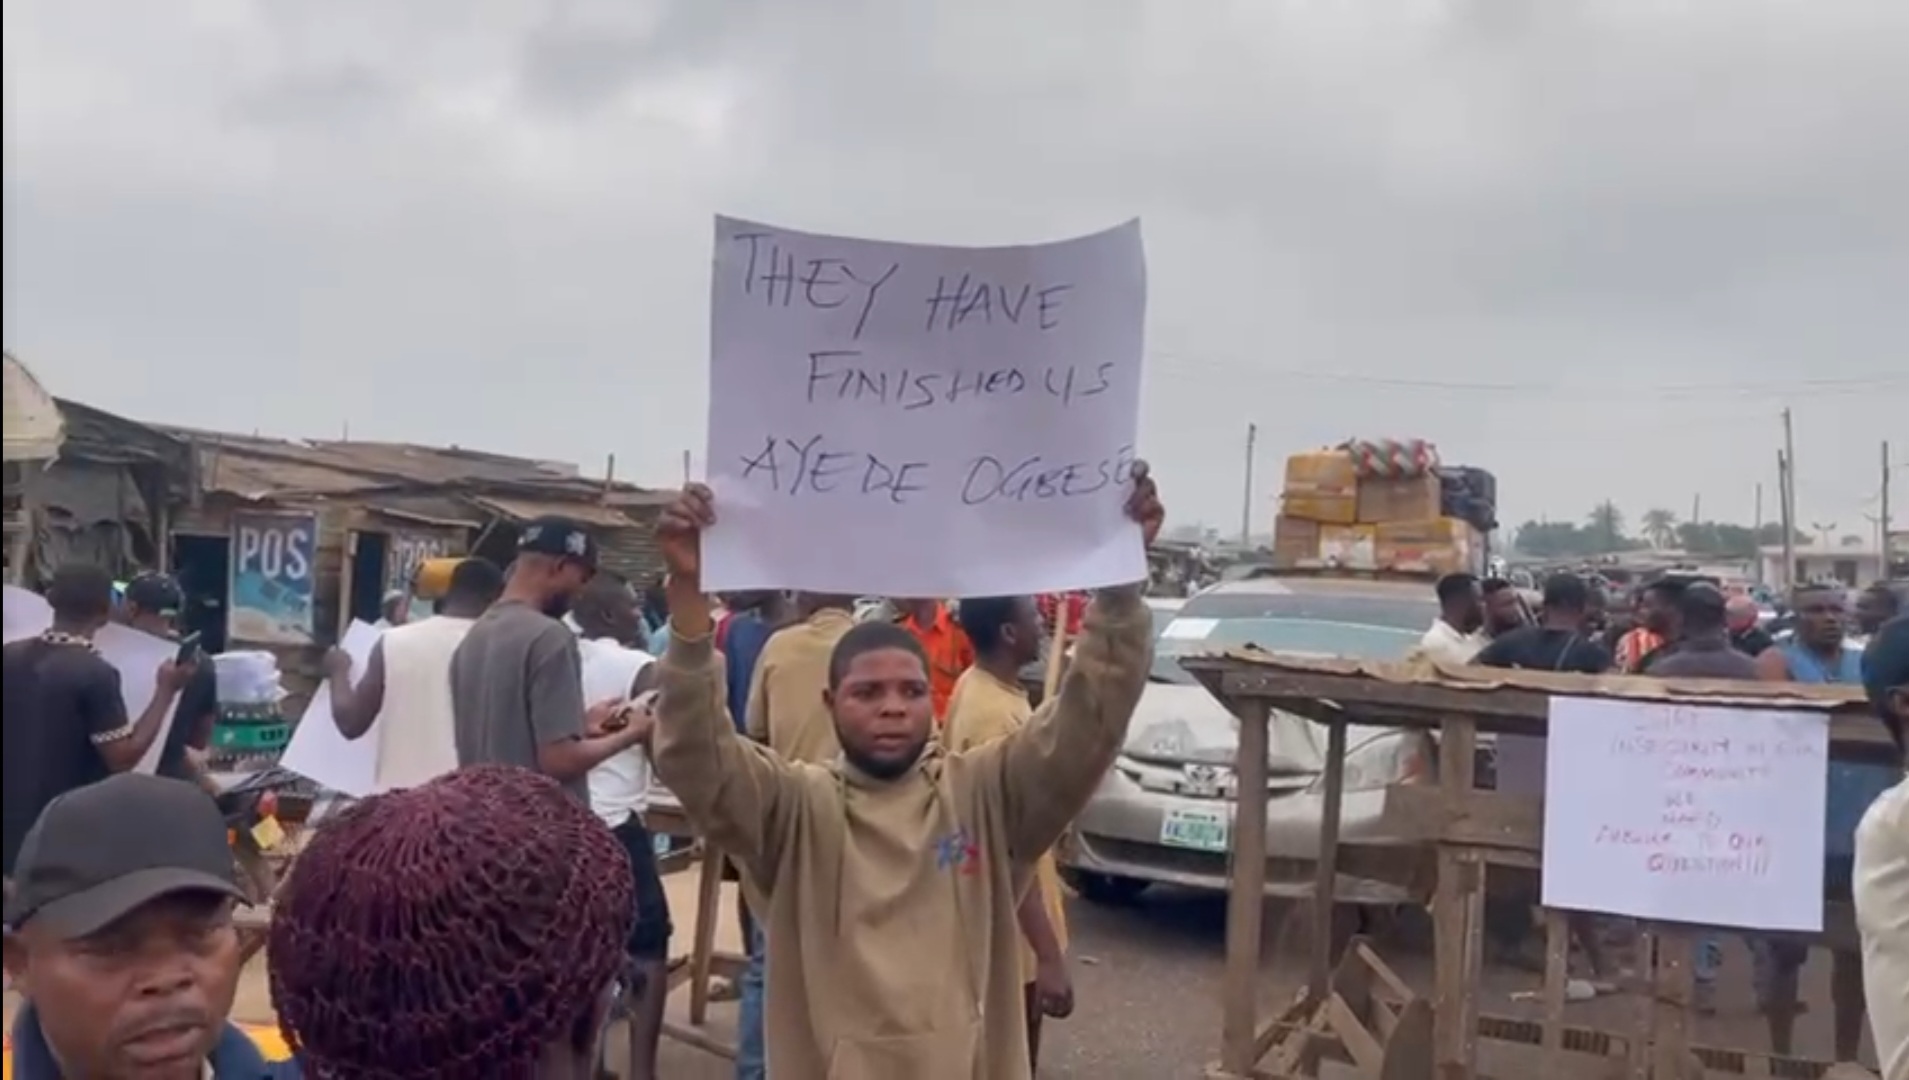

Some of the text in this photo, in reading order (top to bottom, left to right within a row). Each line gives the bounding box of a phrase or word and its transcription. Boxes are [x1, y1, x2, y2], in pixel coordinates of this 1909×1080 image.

[733, 233, 1075, 340] THEY HAVE
[807, 351, 1025, 410] FINISHED
[740, 434, 929, 504] AYEDE
[239, 526, 309, 580] POS
